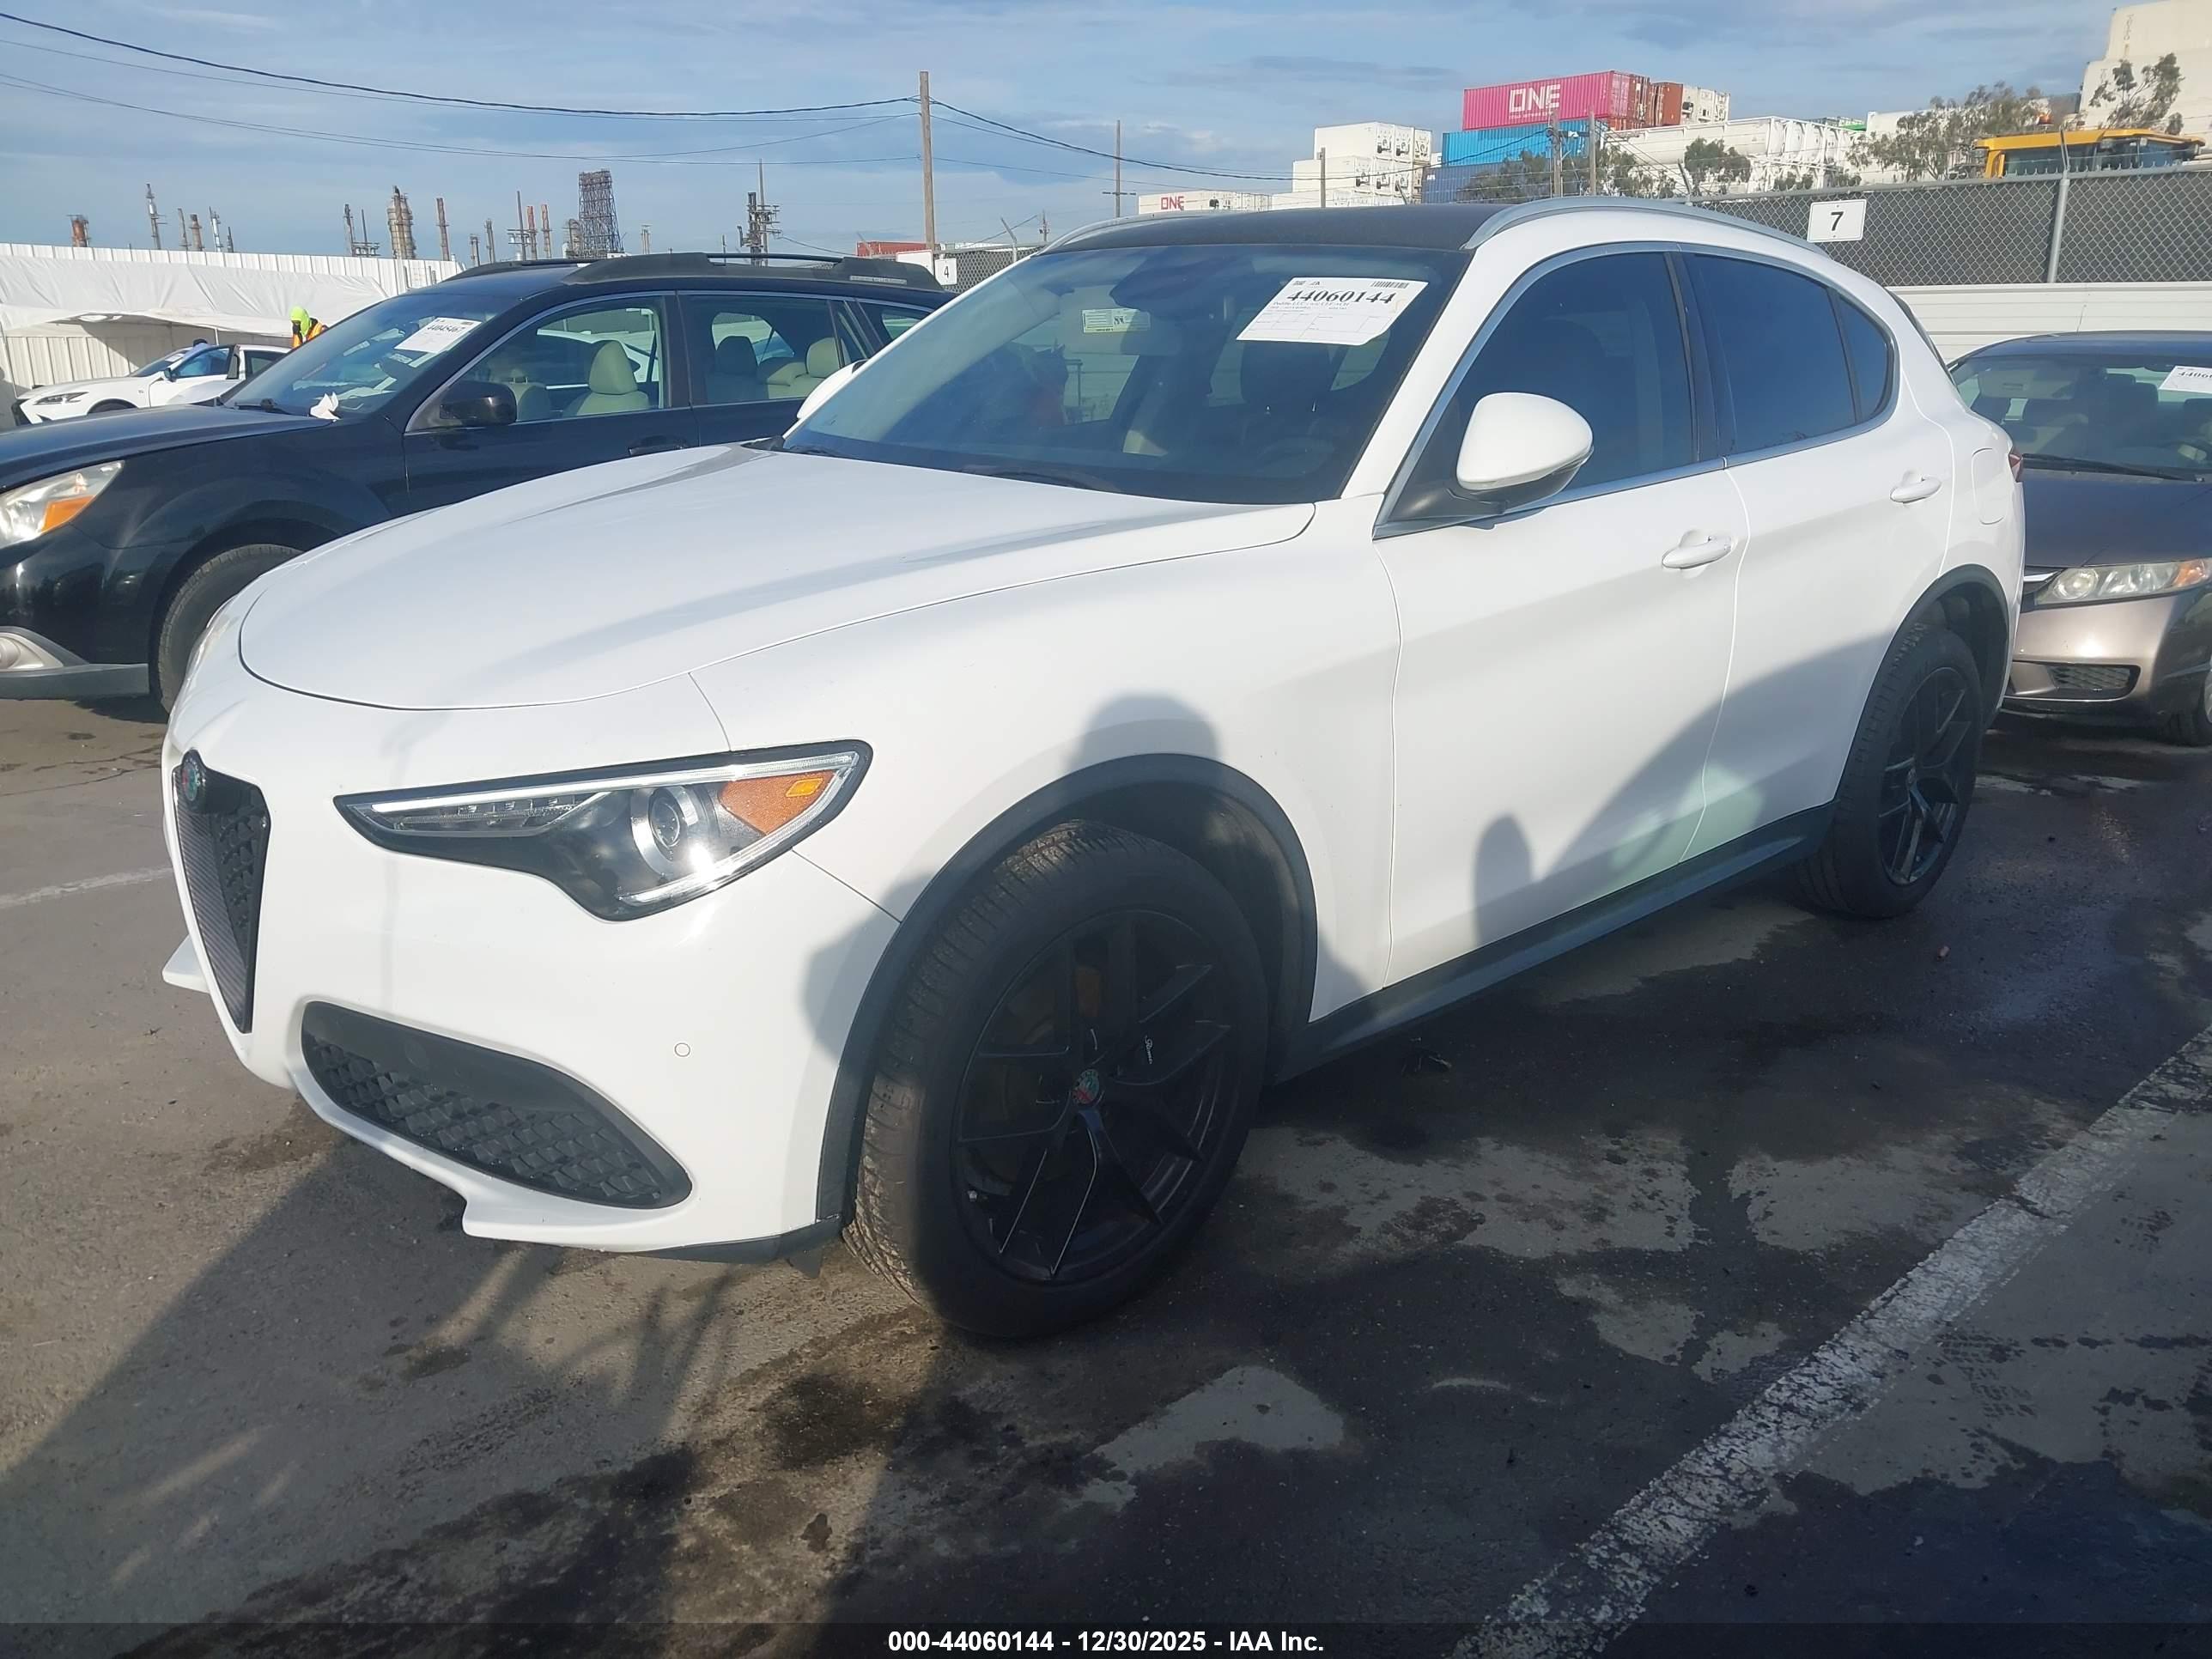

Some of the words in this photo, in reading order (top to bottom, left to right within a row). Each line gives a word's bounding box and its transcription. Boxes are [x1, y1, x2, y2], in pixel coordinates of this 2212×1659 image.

[1509, 84, 1561, 113] ONE
[1160, 196, 1185, 210] ONE
[1831, 211, 1844, 231] 7
[944, 265, 950, 278] 4
[1286, 289, 1398, 305] 44060144
